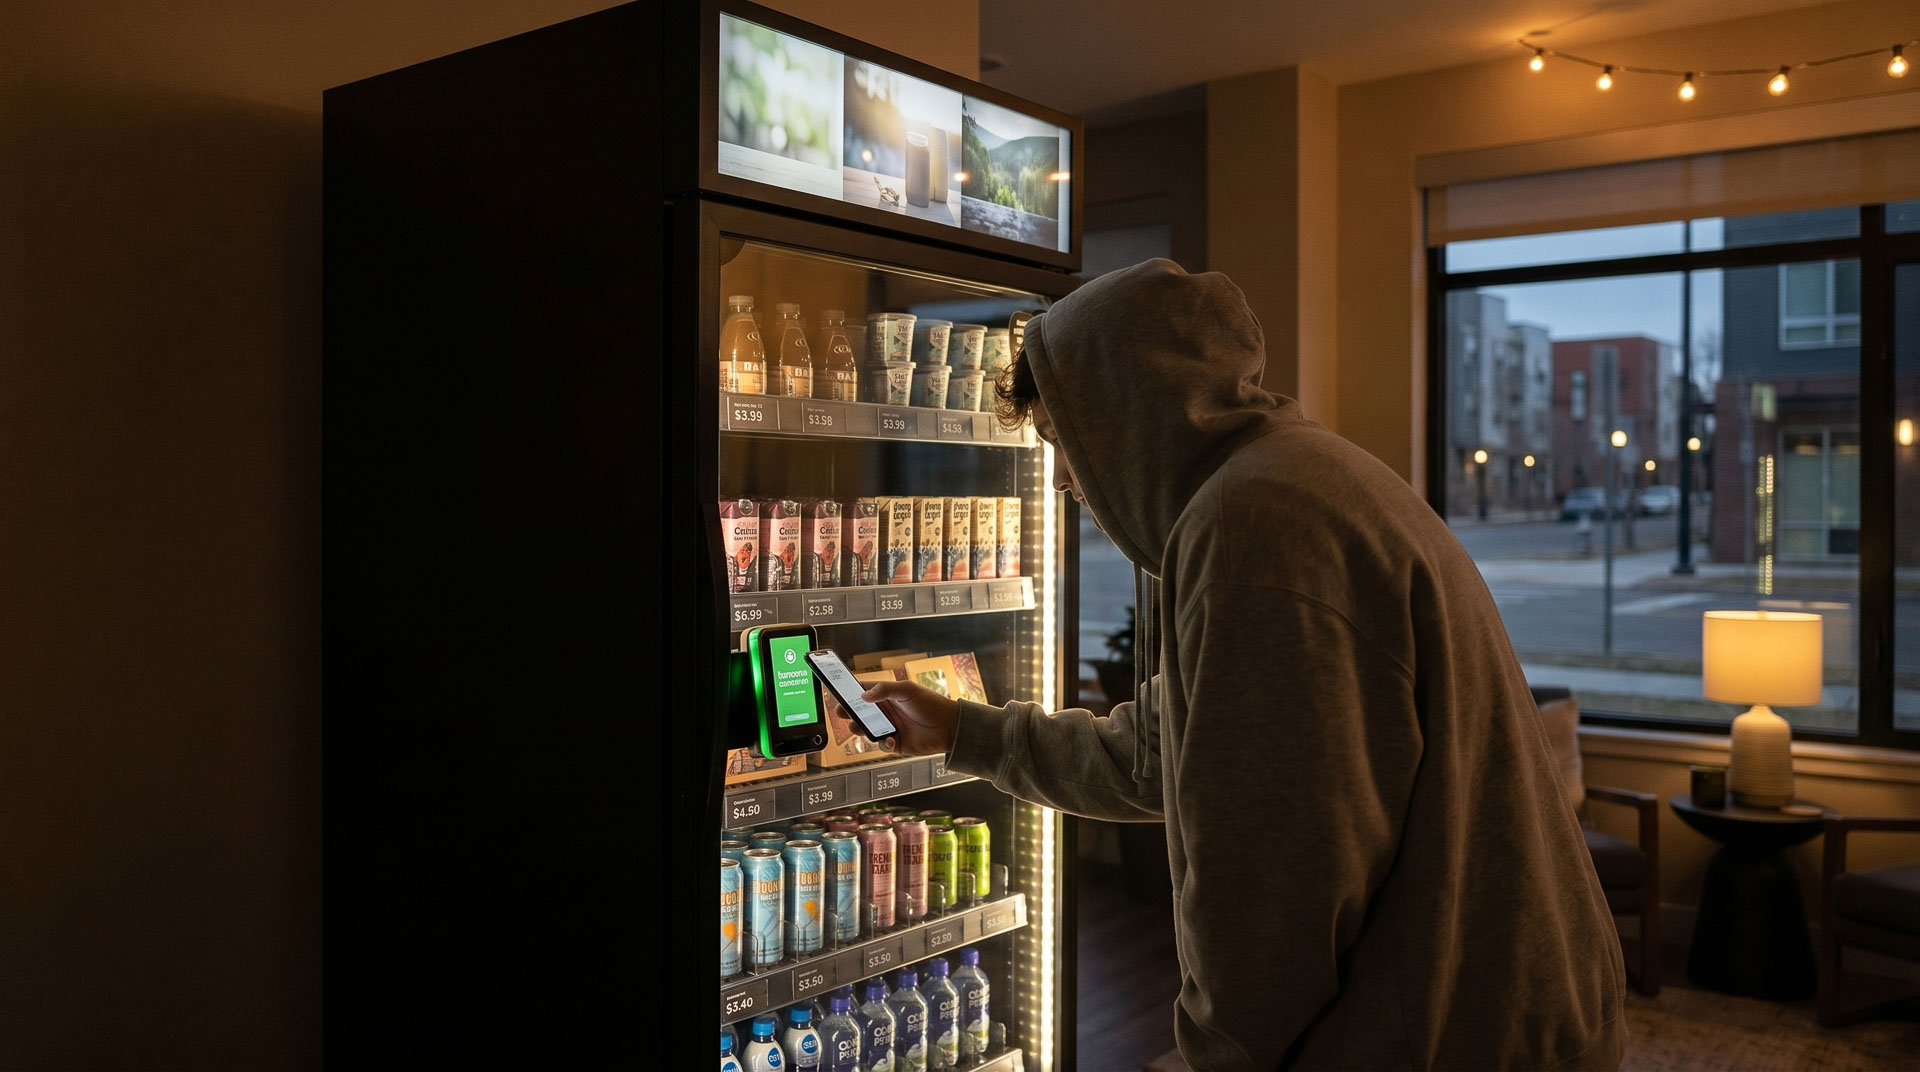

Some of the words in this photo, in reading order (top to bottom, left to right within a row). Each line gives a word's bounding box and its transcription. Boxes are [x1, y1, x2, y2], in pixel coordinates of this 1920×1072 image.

[734, 409, 763, 422] $3.99
[883, 419, 905, 430] $3.99
[881, 599, 903, 611] $3.59
[940, 596, 961, 606] $2.99
[734, 609, 762, 622] $6.99
[809, 605, 834, 616] $2.58
[877, 777, 900, 791] $3.99
[808, 790, 833, 805] $3.99
[868, 952, 891, 968] $3.50
[798, 974, 824, 992] $3.50
[725, 997, 754, 1016] $3.40
